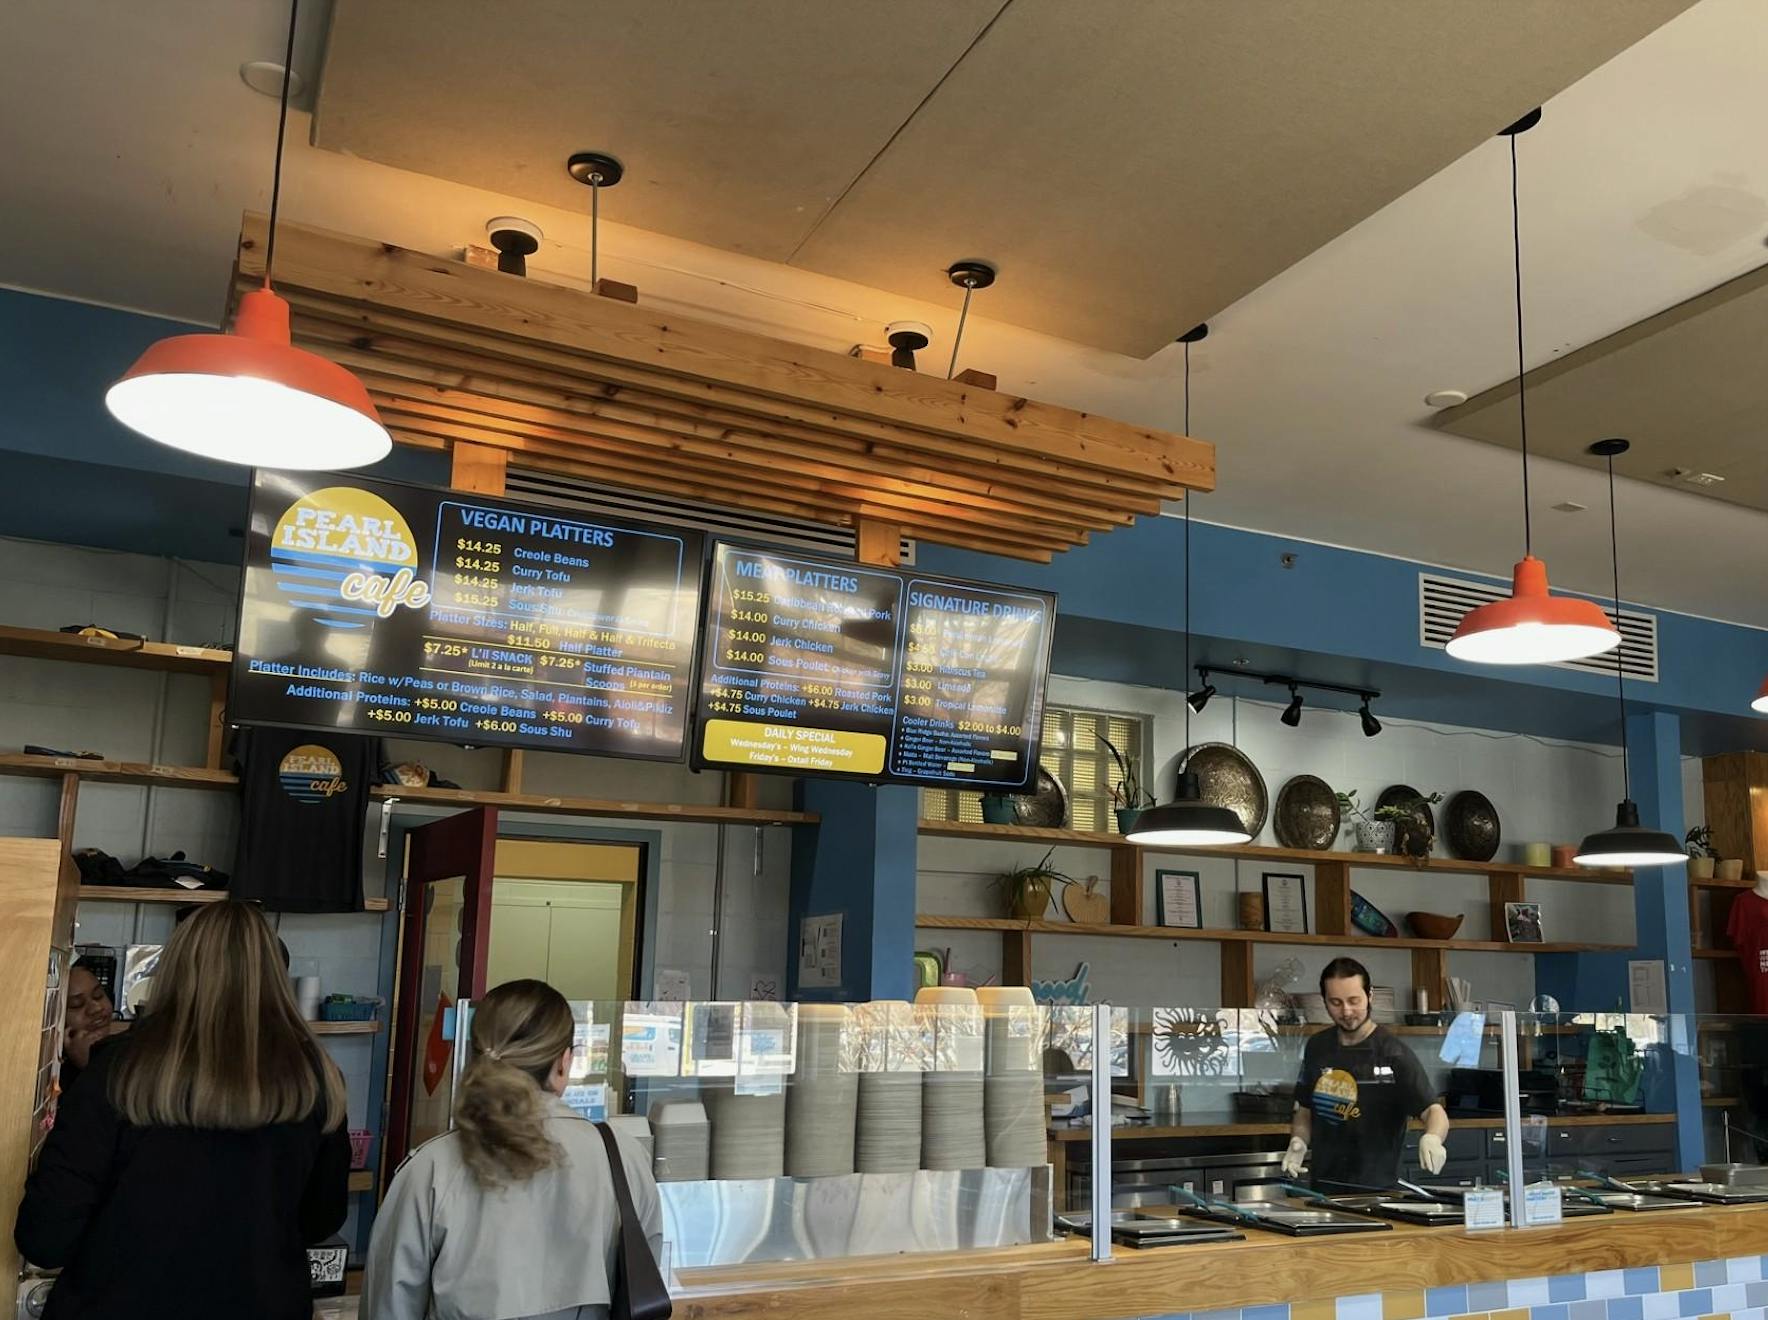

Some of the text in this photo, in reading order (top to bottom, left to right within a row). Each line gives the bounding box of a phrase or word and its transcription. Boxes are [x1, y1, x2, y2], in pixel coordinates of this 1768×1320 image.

[295, 507, 401, 539] PEARL
[461, 509, 614, 548] VEGAN PLATTERS
[281, 525, 412, 562] ISLAND
[457, 538, 590, 568] $14.25 Creole Beans
[455, 556, 570, 583] $14.25 Curry Tofu
[786, 567, 859, 593] PLATTERS
[340, 567, 432, 618] cafe
[454, 574, 563, 598] $14.25 Jerk Tofu
[454, 591, 498, 608] $15.25
[733, 589, 770, 604] $15.25
[870, 607, 892, 620] Pork
[910, 591, 1043, 624] SIGNATURE DRINKS
[430, 610, 676, 651] Platter Sizes: Half, Full, Half & Half & Trifecta
[730, 609, 841, 632] $14.00 Curry Chicken
[507, 634, 624, 658] $11.50 Half Platter
[728, 629, 834, 653] $14.00 Jerk Chicken
[491, 651, 533, 665] SNACK
[584, 661, 624, 676] Stuffed
[626, 667, 671, 681] Plantain
[512, 665, 534, 675] carte)
[726, 649, 764, 664] $14.00
[768, 655, 793, 668] Sous
[906, 661, 933, 673] $3.00
[939, 665, 971, 677] Hibiscus
[250, 659, 295, 675] Platter
[298, 665, 355, 681] Includes:
[359, 671, 385, 685] Rice
[389, 675, 433, 689] w/Peas
[437, 681, 448, 690] or
[451, 682, 489, 697] Brown
[491, 685, 518, 700] Rice,
[521, 688, 553, 703] Salad,
[558, 692, 611, 708] Plantains,
[585, 677, 625, 691] Scoops
[711, 673, 892, 703] Additional Proteins: +$6.00 Roasted Pork
[905, 678, 932, 690] $3.00
[286, 684, 640, 730] Additional Proteins: +$5.00 Creole Beans +$5.00 Curry Tofu
[708, 702, 797, 720] +$4.75 Sous Poulet
[710, 687, 894, 716] +$4.75 Curry Chicken +$4.75 Jerk Chicken
[904, 694, 931, 706] $3.00
[936, 699, 966, 711] Tropical
[367, 708, 573, 739] +$5.00 Jerk Tofu +$6.00 Sous Shu
[764, 726, 836, 744] DAILY SPECIAL
[902, 715, 1021, 736] Cooler Drinks $2.00 to $4.00
[730, 737, 853, 758] Wednesday's Wing Wednesday
[749, 751, 779, 763] Friday's
[811, 757, 833, 768] Friday
[311, 777, 348, 797] cafe
